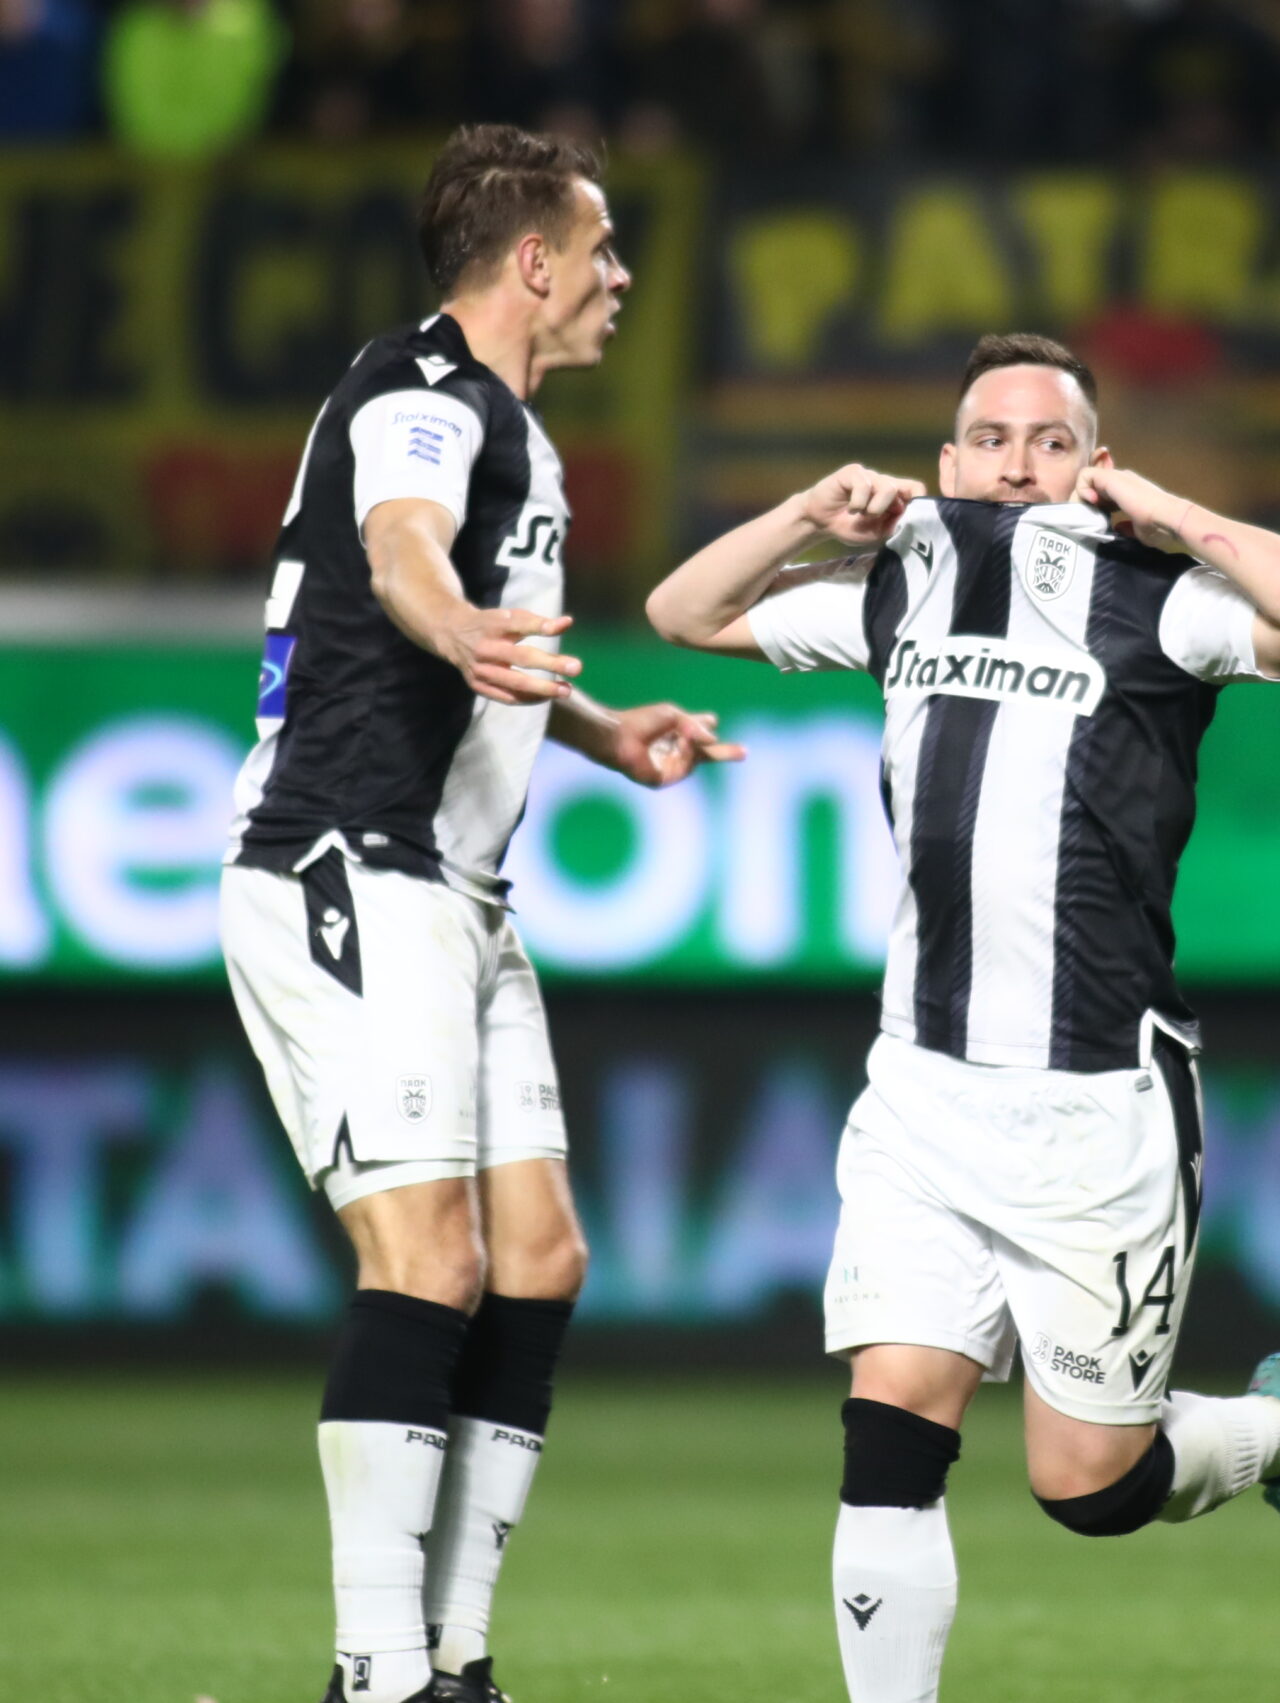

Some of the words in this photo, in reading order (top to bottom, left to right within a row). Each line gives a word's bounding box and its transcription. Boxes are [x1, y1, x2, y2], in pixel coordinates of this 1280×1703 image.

[1111, 1246, 1175, 1336] 14
[1051, 1358, 1106, 1384] STORE
[1054, 1346, 1102, 1371] PAOK
